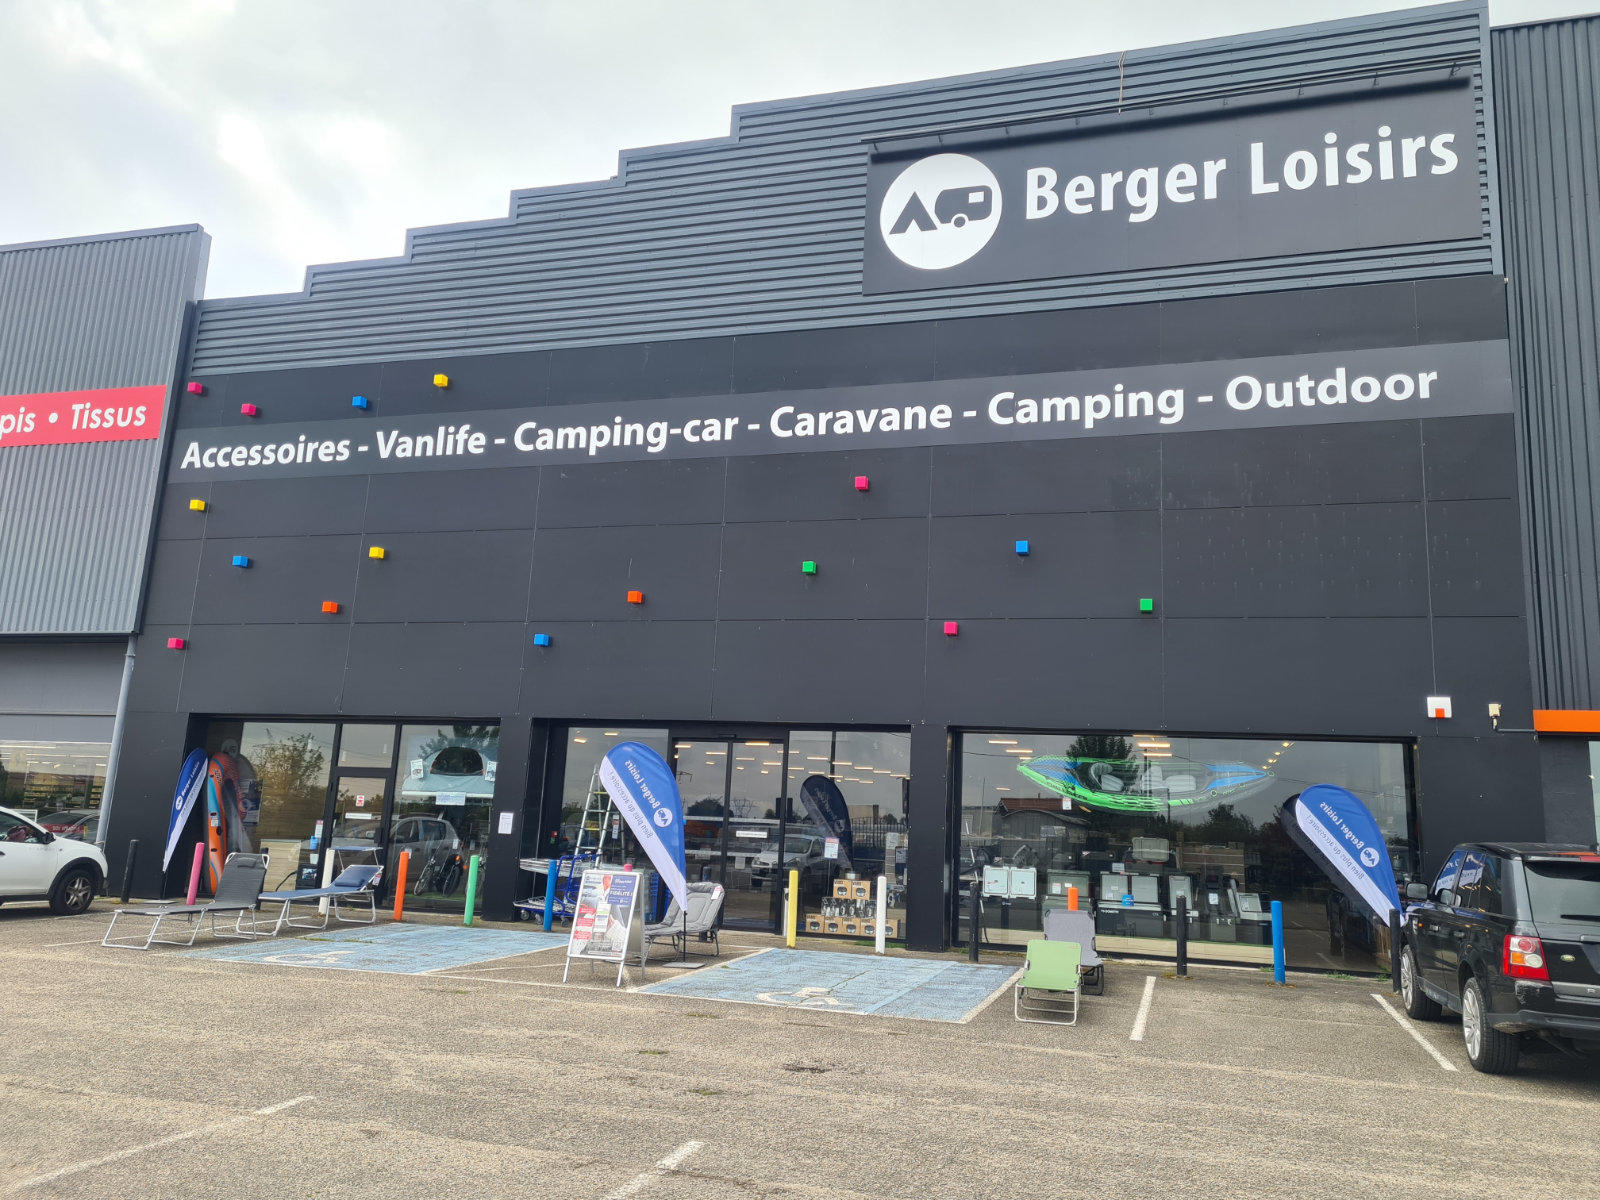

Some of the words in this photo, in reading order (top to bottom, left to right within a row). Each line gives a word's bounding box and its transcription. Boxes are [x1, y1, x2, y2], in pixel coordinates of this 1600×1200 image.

[1025, 157, 1227, 223] Berger
[1250, 125, 1459, 195] Loisirs
[71, 402, 147, 430] Tissus
[180, 434, 351, 470] Accessoires
[375, 423, 487, 459] Vanlife
[513, 415, 740, 456] Camping-car
[769, 403, 953, 438] Caravane
[987, 383, 1185, 430] Camping
[1225, 366, 1438, 411] Outdoor
